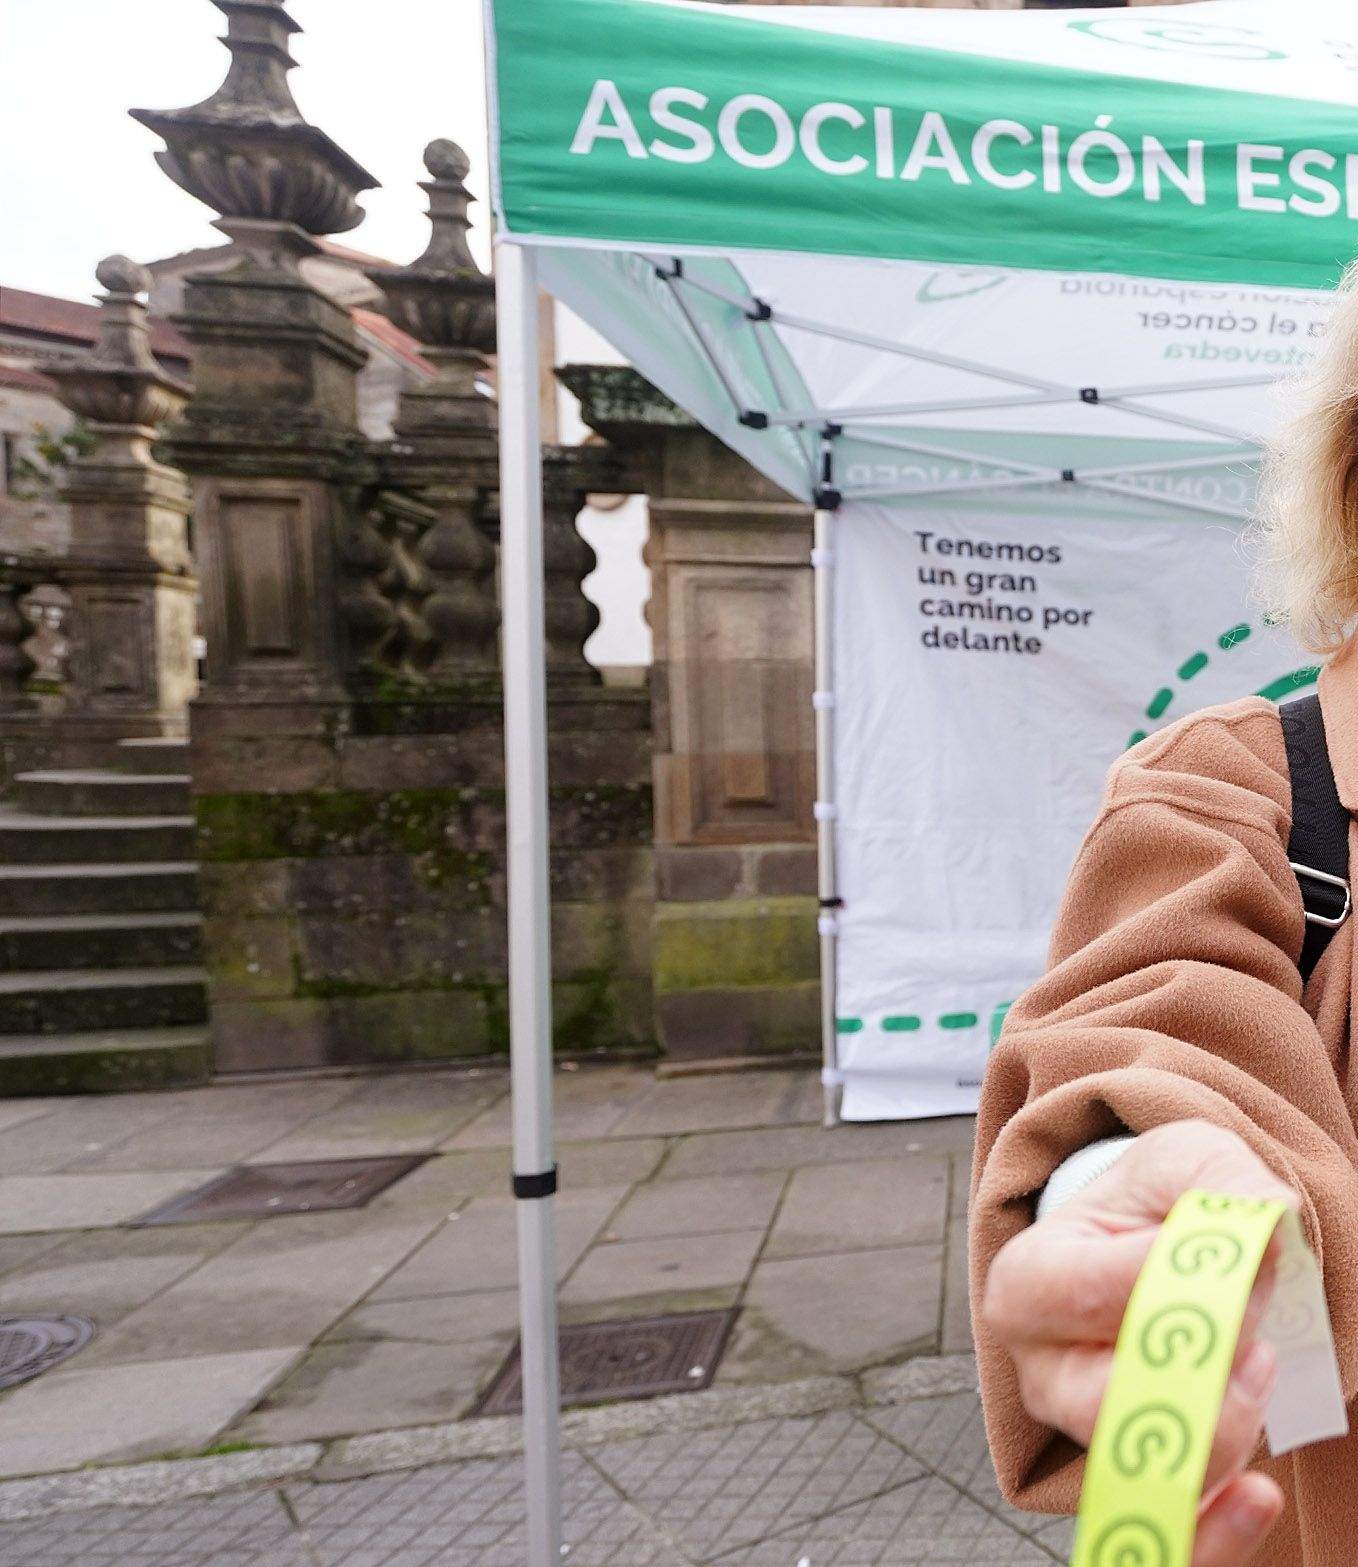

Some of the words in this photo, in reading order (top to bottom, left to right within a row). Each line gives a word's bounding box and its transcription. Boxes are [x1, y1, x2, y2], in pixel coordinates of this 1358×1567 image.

[569, 79, 1207, 206] ASOCIACIÓN
[914, 530, 1062, 565] Tenemos
[918, 566, 958, 588] un
[966, 570, 1037, 597] gran
[919, 598, 1033, 625] camino
[1042, 606, 1093, 632] por
[921, 626, 1042, 656] delante
